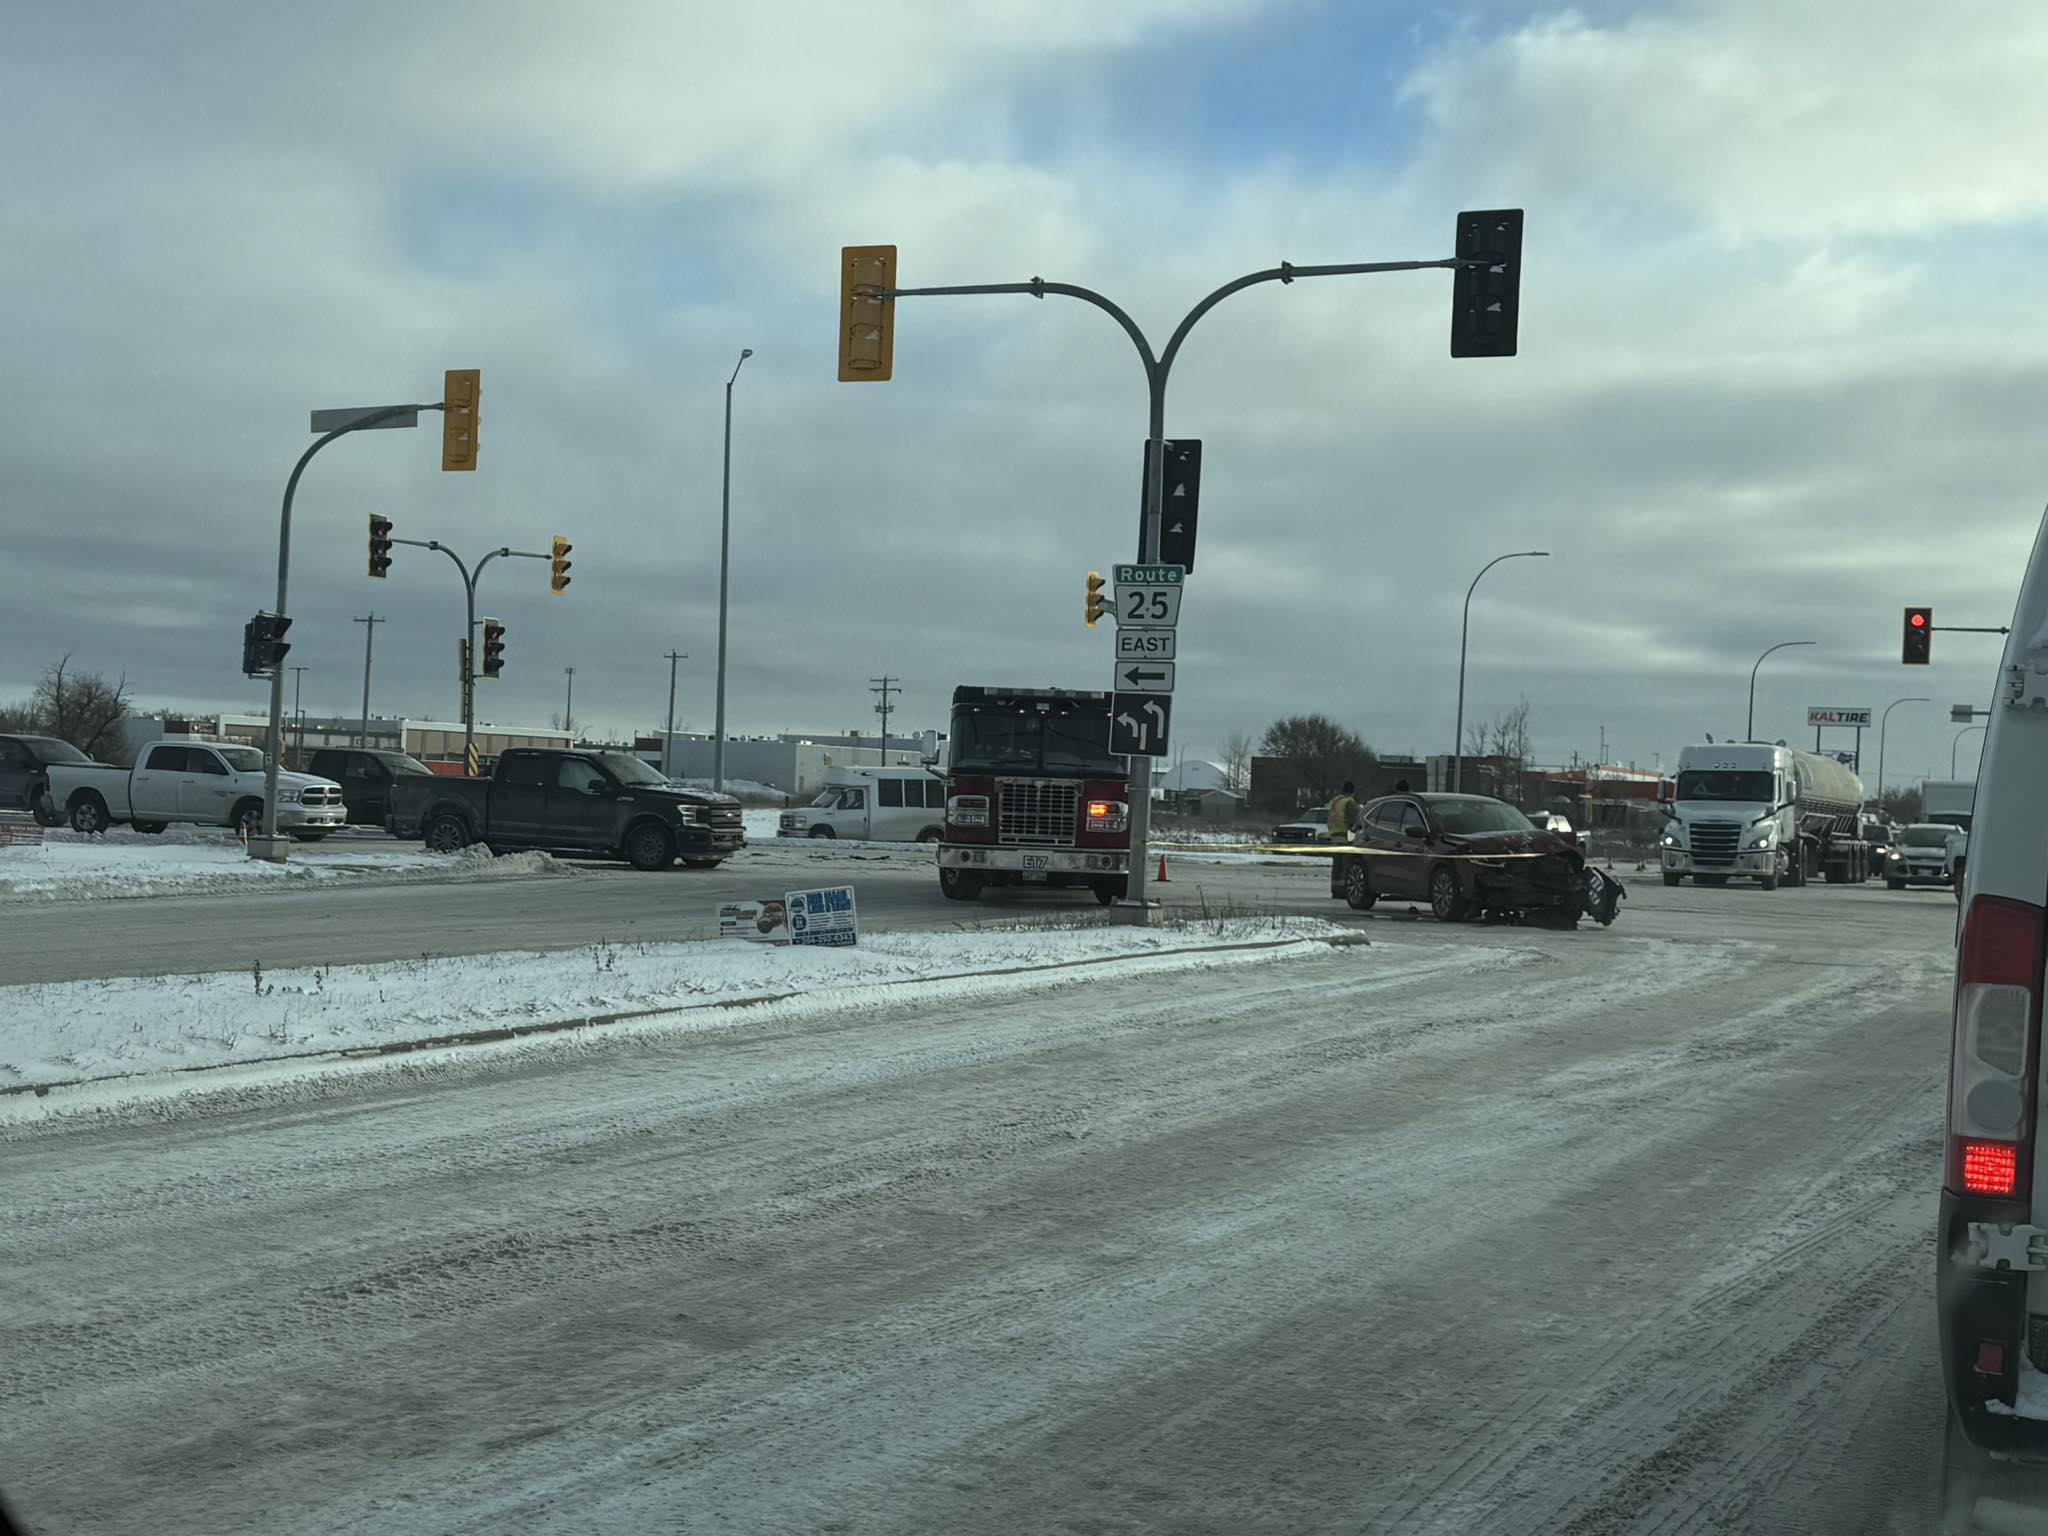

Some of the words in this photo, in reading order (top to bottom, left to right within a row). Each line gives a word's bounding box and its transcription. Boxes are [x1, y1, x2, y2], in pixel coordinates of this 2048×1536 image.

[1120, 567, 1178, 582] Route
[1127, 591, 1169, 620] 25
[1121, 636, 1170, 652] EAST
[1023, 855, 1048, 869] E17
